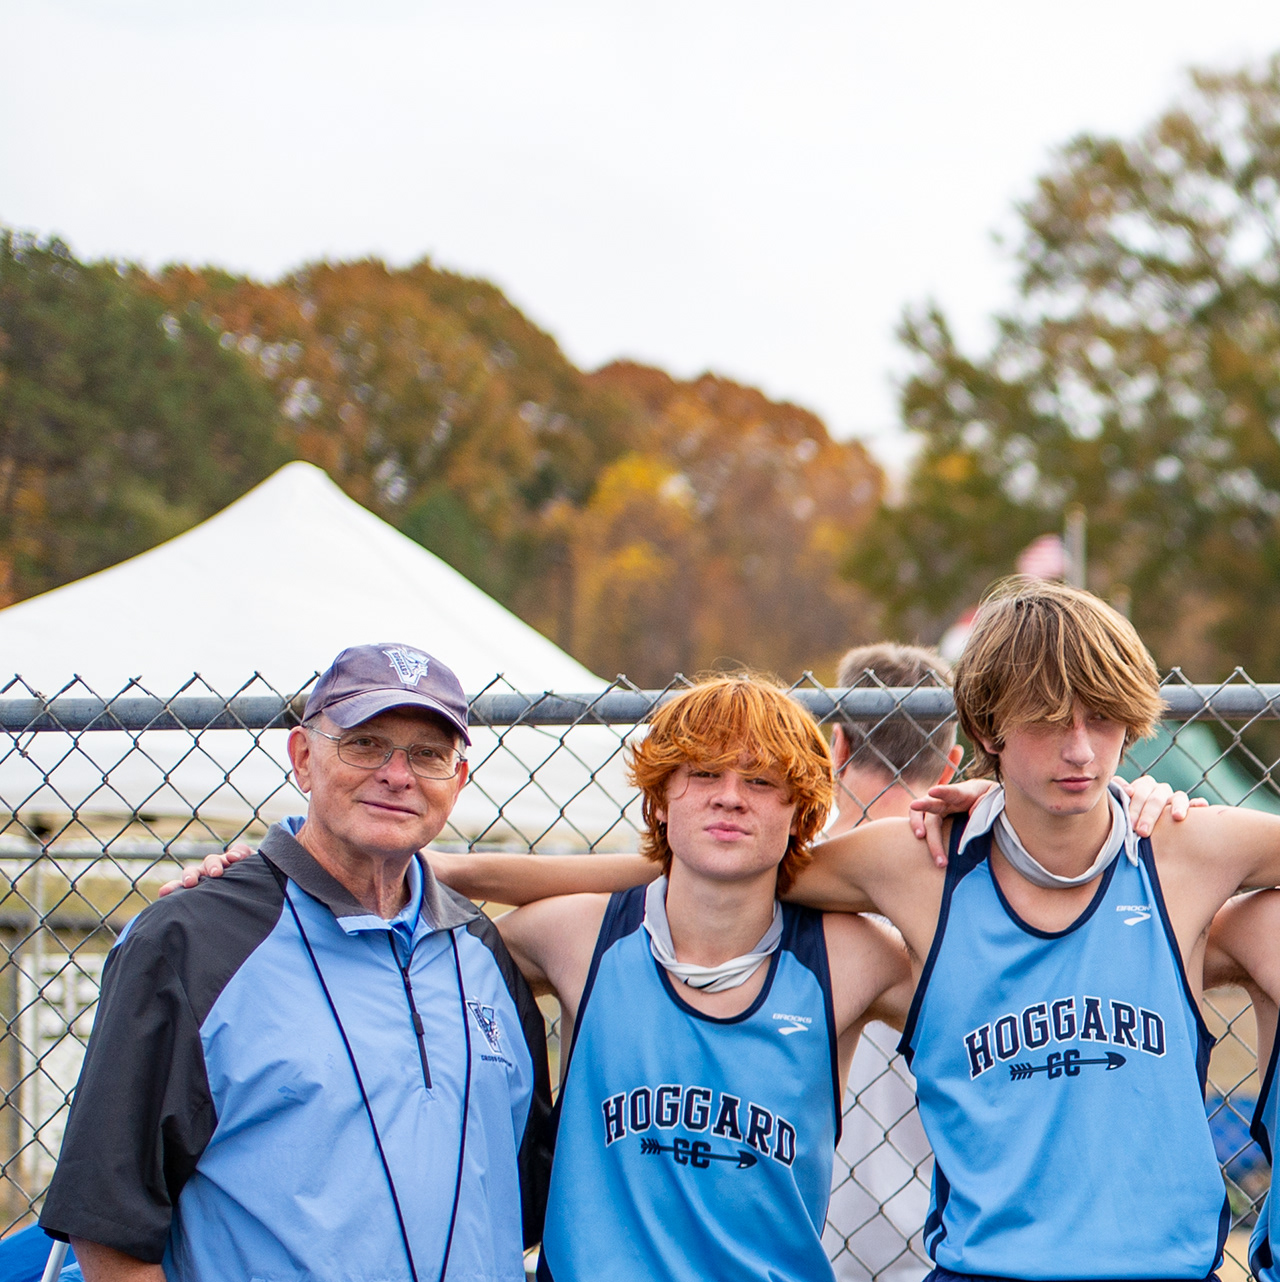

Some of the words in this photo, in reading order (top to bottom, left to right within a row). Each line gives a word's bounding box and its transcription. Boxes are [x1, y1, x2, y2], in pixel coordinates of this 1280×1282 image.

[772, 1013, 813, 1024] BROOKS
[963, 995, 1167, 1081] HOGGARD
[1046, 1049, 1080, 1080] CC
[602, 1083, 796, 1169] HOGGARD
[673, 1138, 711, 1169] CC
